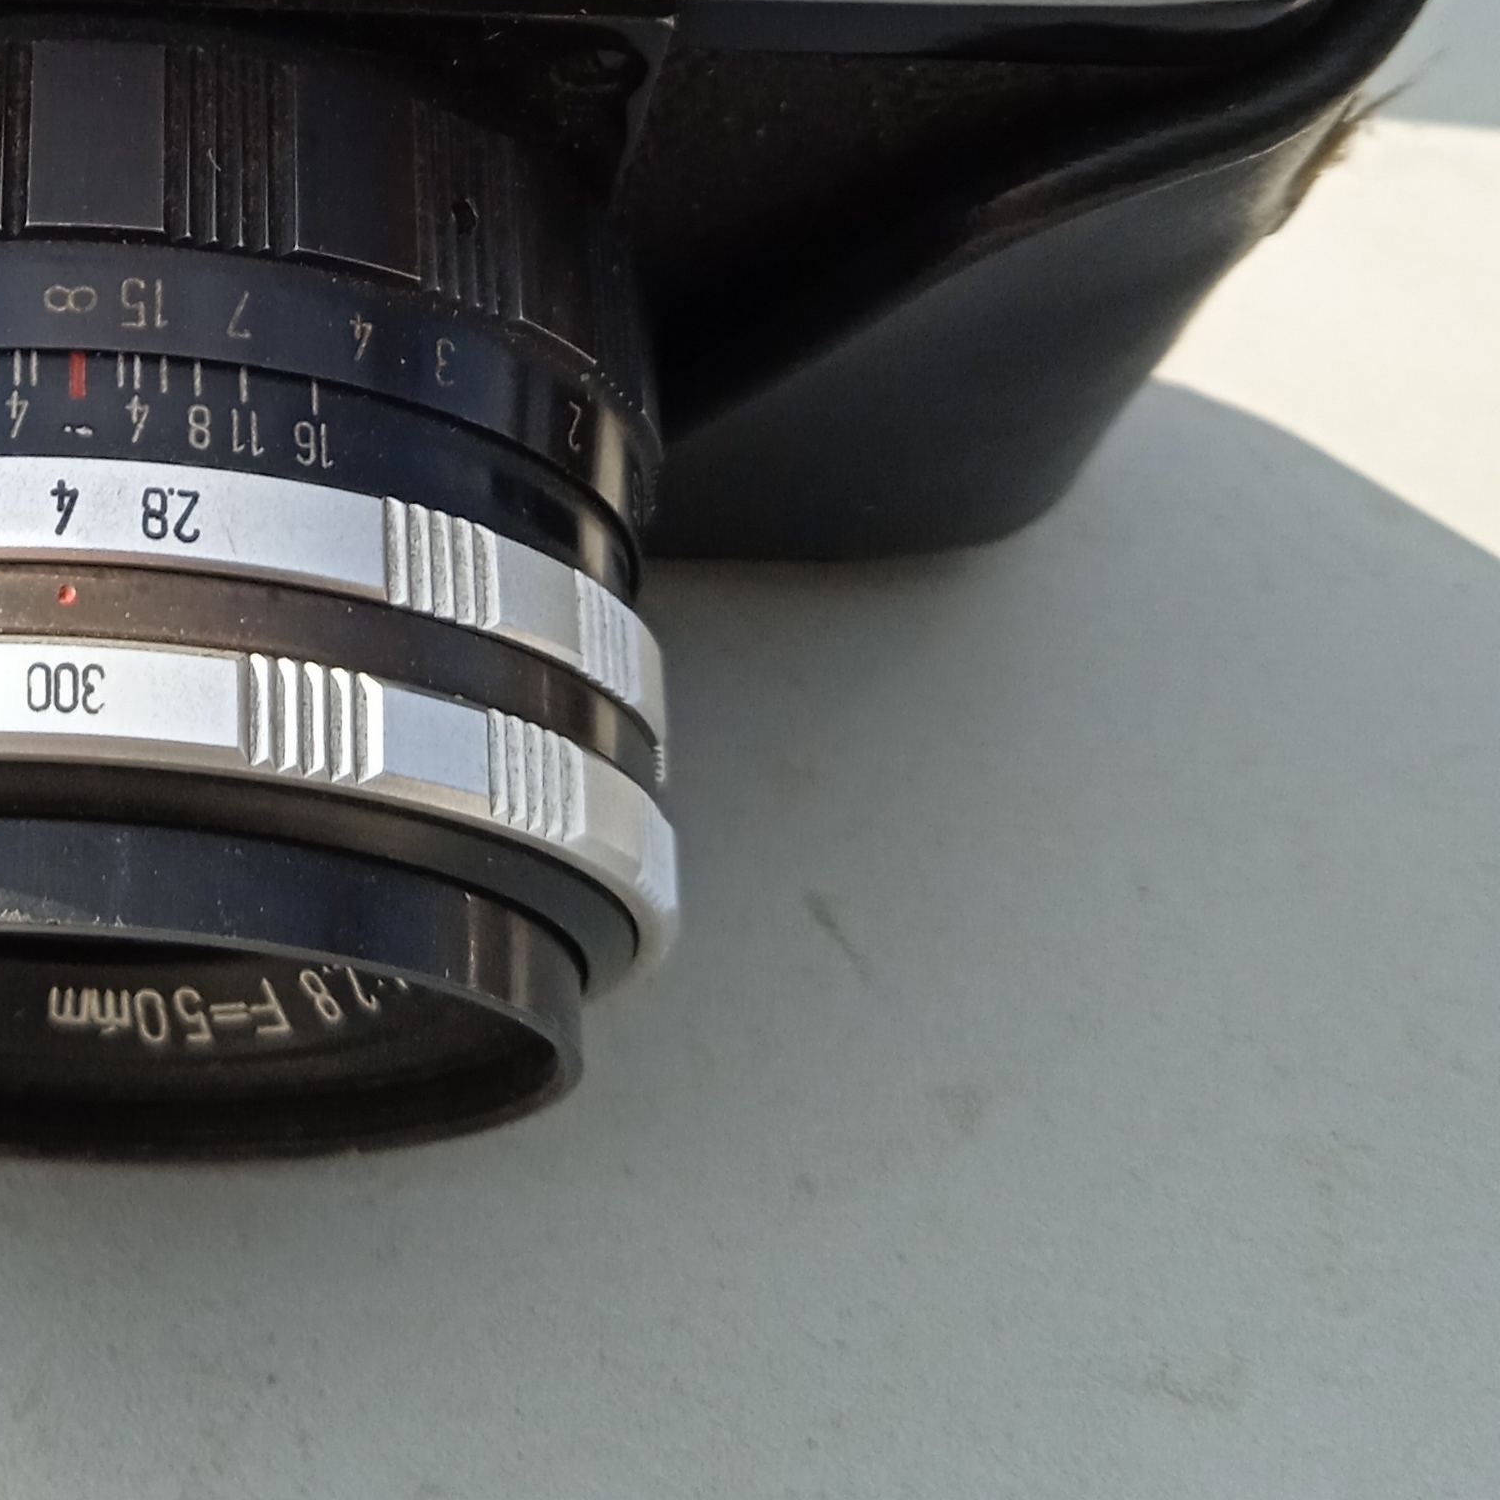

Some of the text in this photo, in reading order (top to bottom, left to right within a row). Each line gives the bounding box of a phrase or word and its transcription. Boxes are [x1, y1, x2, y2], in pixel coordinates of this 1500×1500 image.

[120, 277, 169, 329] 15
[227, 290, 251, 340] 7
[349, 312, 373, 361] 4
[434, 337, 456, 388] 3
[5, 390, 30, 440] 4
[125, 393, 150, 445] 4
[188, 403, 213, 450] 8
[231, 408, 265, 458] 11
[294, 420, 335, 470] 16
[49, 478, 81, 536] 4
[140, 485, 201, 545] 2.8
[25, 660, 107, 715] 300
[48, 976, 293, 1045] F=50mm
